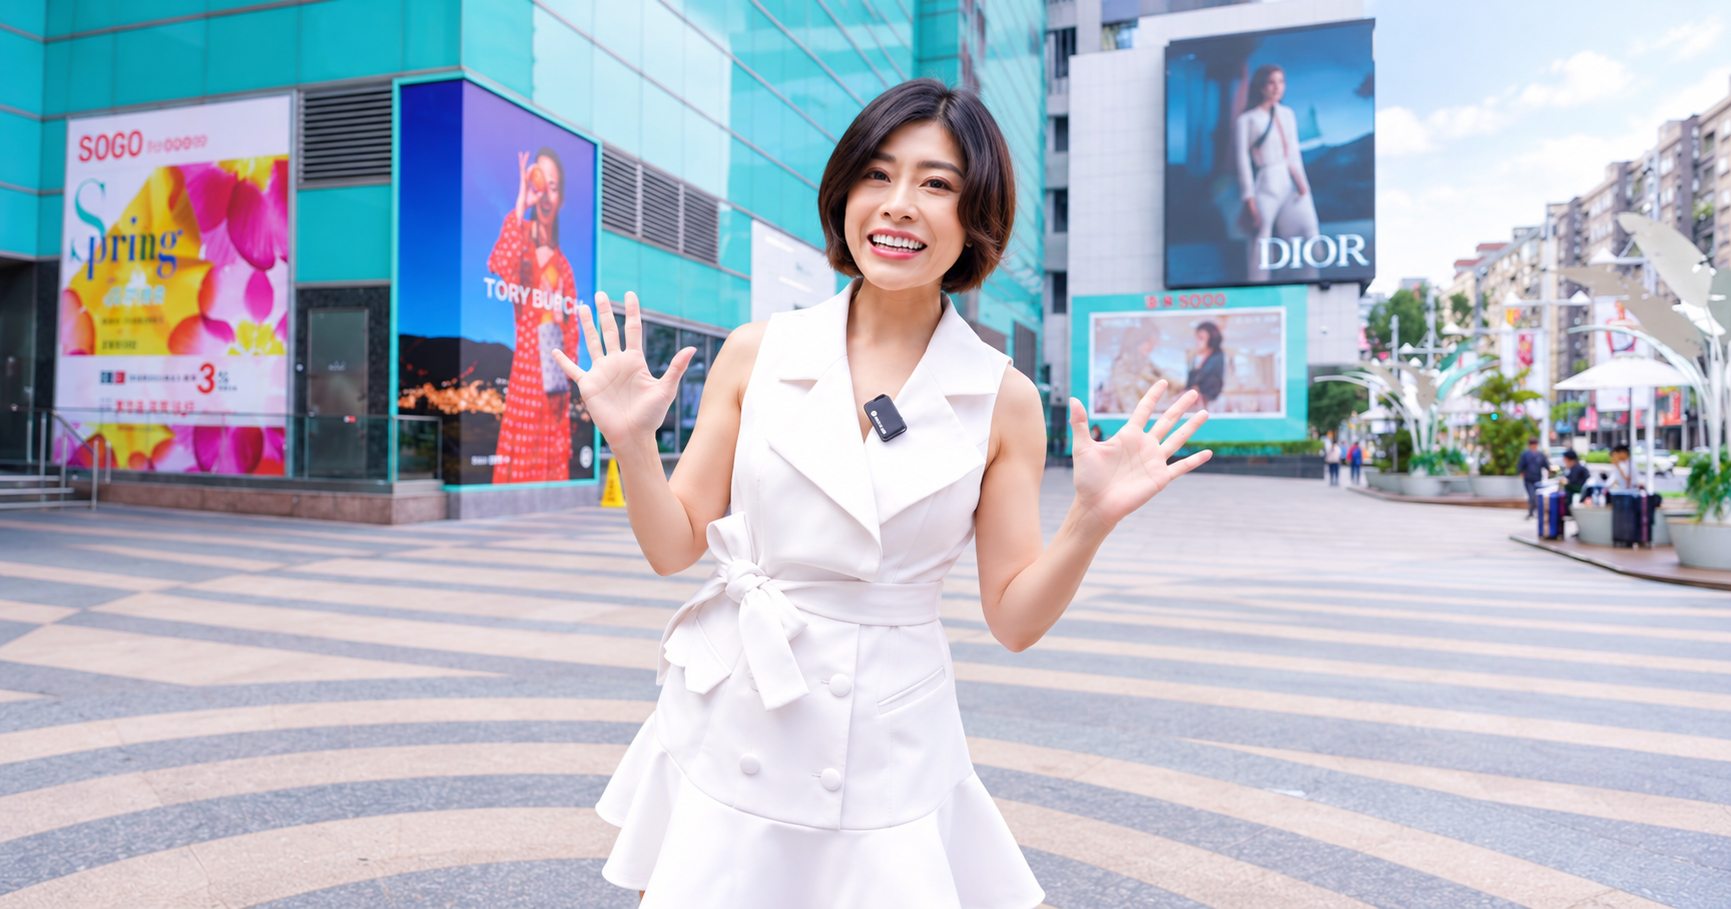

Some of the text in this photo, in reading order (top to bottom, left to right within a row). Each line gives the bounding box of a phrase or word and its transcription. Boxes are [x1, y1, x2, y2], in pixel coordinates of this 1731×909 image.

[79, 130, 143, 162] SOGO
[70, 178, 183, 280] Spring
[1258, 234, 1370, 270] DIOR
[483, 277, 531, 305] TORY
[197, 362, 215, 394] 3
